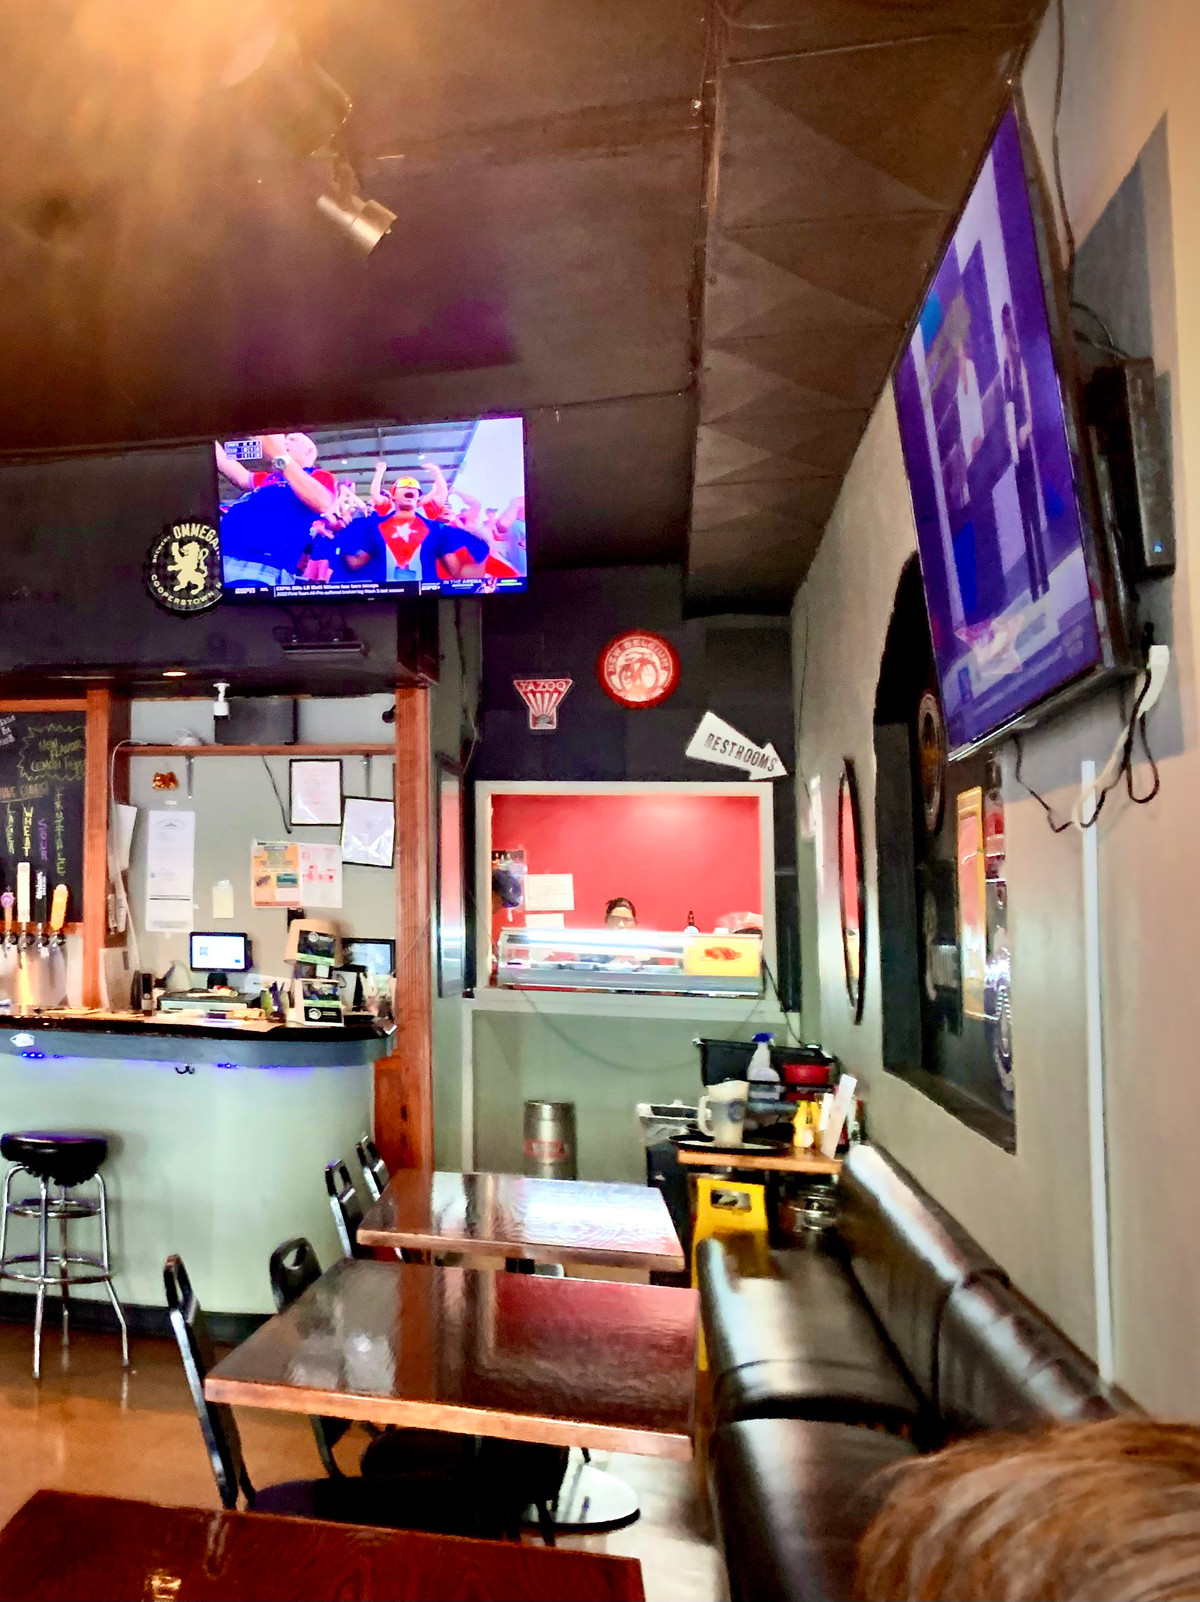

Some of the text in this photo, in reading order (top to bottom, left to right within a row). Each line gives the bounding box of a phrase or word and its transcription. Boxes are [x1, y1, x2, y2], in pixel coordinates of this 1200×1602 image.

[173, 523, 220, 560] OMMEGA
[151, 574, 215, 605] COOPERSTOWN
[623, 639, 669, 671] BELGIUM
[519, 680, 567, 692] YAZOO
[703, 732, 779, 773] RESTROOMS
[23, 806, 34, 857] WHEAT
[38, 818, 48, 860] SOUR
